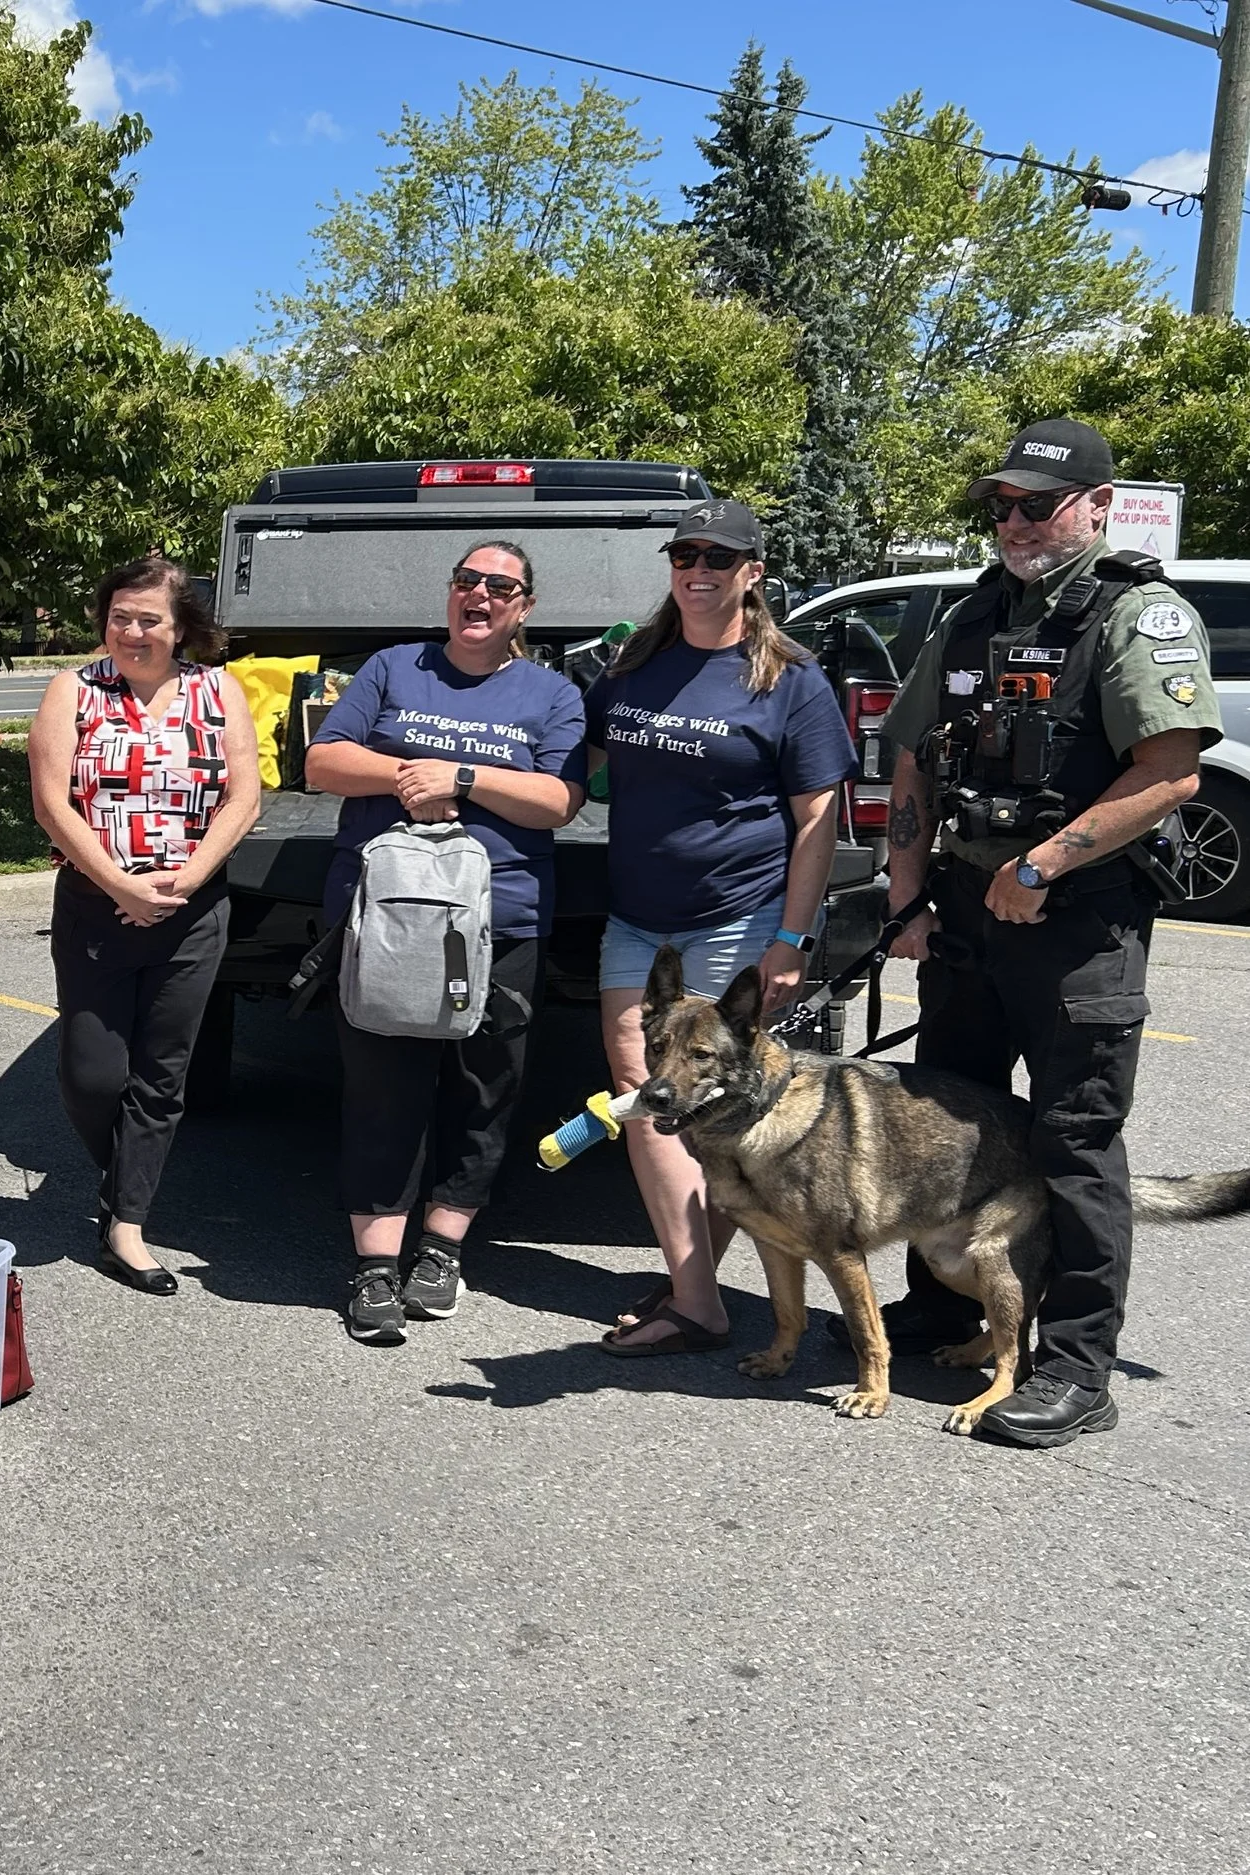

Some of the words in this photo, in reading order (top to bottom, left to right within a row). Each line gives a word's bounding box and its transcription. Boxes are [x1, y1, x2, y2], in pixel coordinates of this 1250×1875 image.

[1023, 442, 1071, 462] SECURITY
[1113, 512, 1130, 524] PICK
[1131, 513, 1141, 524] UP
[1141, 514, 1150, 525] IN
[1123, 499, 1138, 509] BUY
[396, 709, 488, 733] Mortgages
[492, 723, 528, 743] with
[608, 701, 686, 728] Mortgages
[689, 717, 729, 737] with
[404, 728, 456, 751] Sarah
[461, 737, 514, 761] Turck
[607, 724, 649, 746] Sarah
[655, 732, 707, 758] Turck
